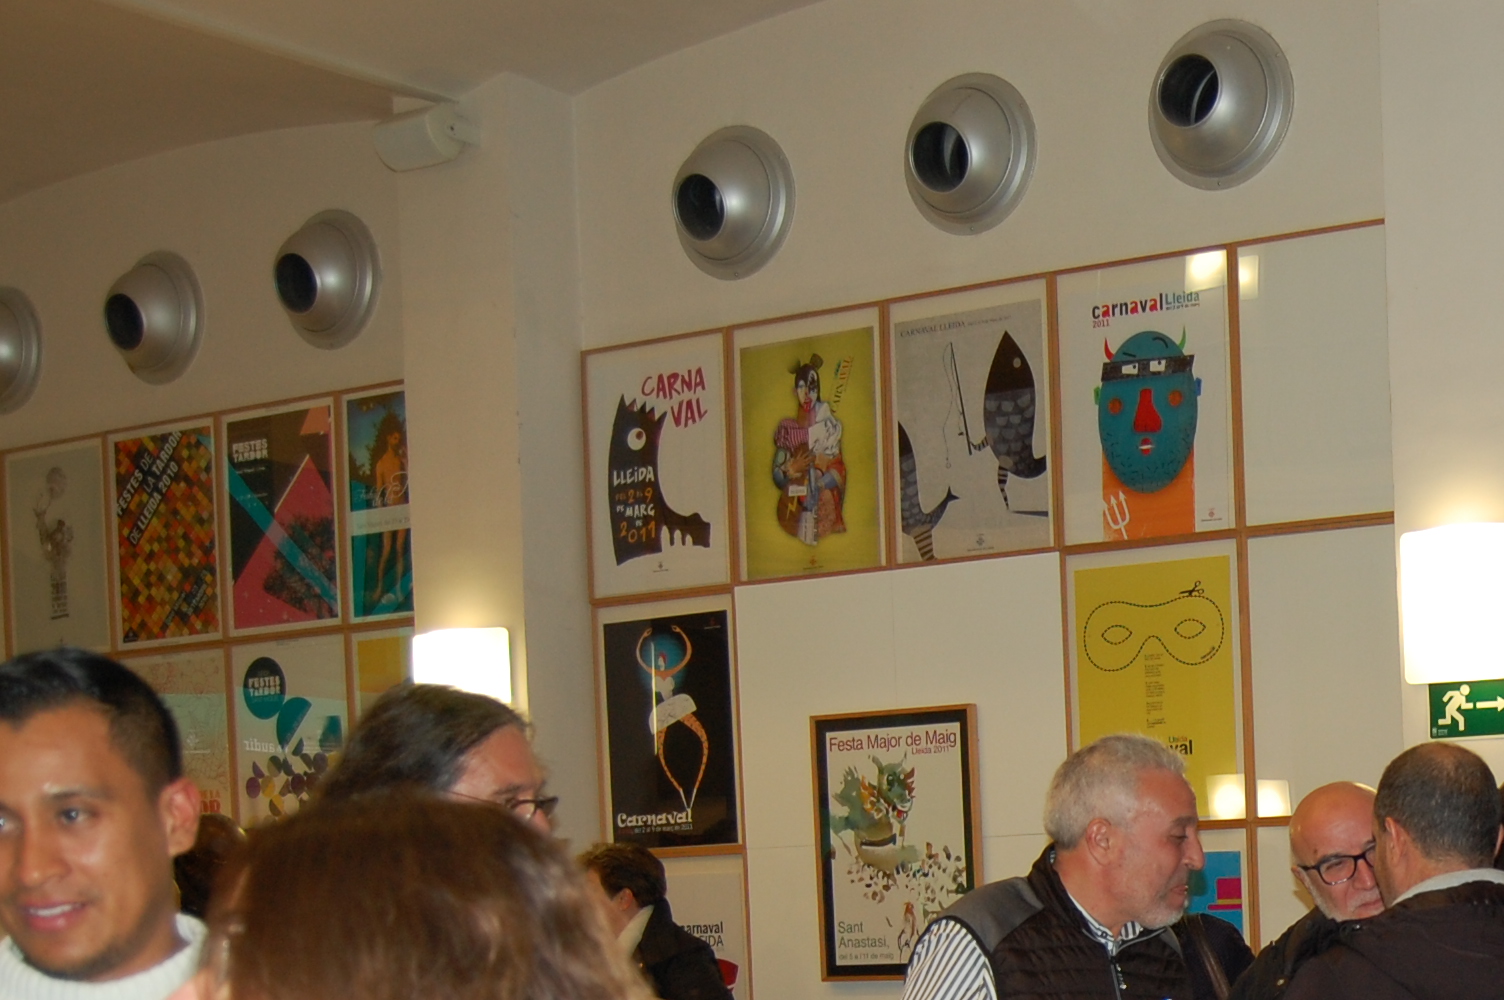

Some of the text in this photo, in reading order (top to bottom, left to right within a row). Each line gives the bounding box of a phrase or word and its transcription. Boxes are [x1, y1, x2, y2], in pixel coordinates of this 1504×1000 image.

[1092, 291, 1200, 319] carnaval Lleida
[1092, 319, 1110, 328] 2011
[641, 366, 706, 400] CARNA
[670, 397, 708, 429] VAL
[232, 438, 268, 452] FESTES
[143, 430, 182, 494] LA TARDOR
[116, 451, 154, 517] FESTES DE
[130, 461, 179, 545] DE LLEIDA 2010
[619, 520, 656, 543] 2011
[248, 675, 280, 688] FESTES
[829, 729, 957, 753] Festa Major de Maig
[933, 745, 949, 754] 2011
[617, 808, 693, 827] Carnaval
[838, 921, 863, 934] Sant
[838, 935, 890, 949] Anastasi,
